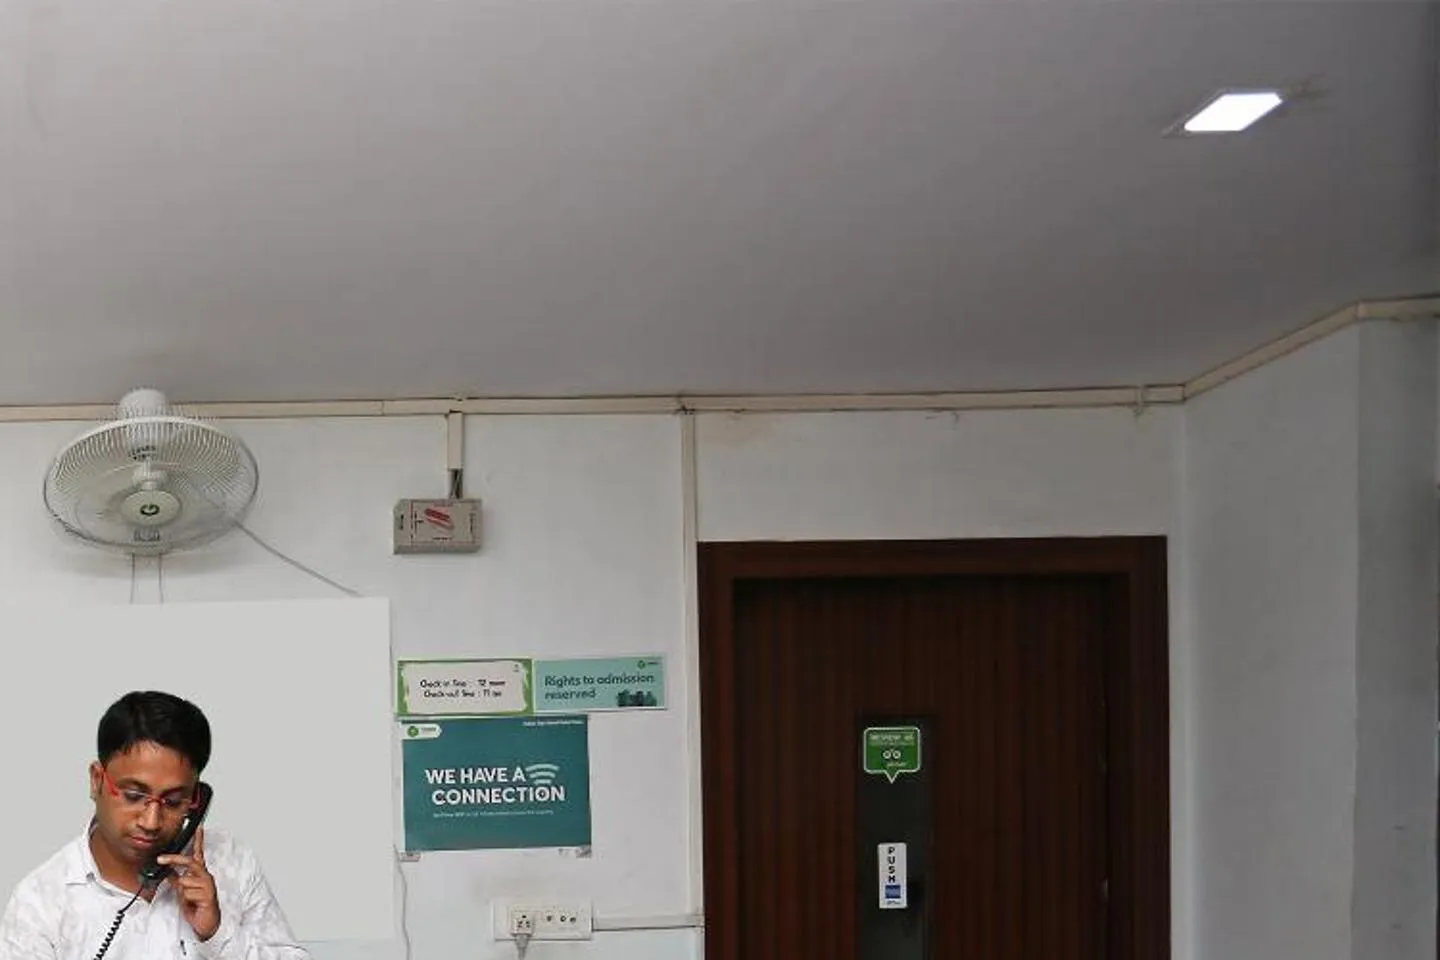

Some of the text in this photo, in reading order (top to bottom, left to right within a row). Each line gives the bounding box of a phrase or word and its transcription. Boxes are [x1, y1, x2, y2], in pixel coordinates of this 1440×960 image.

[544, 672, 655, 688] Rights to admission
[544, 688, 596, 700] reserved
[424, 766, 526, 785] WE HAVE A
[432, 785, 566, 806] CONNECTION
[887, 846, 896, 884] PUSH
